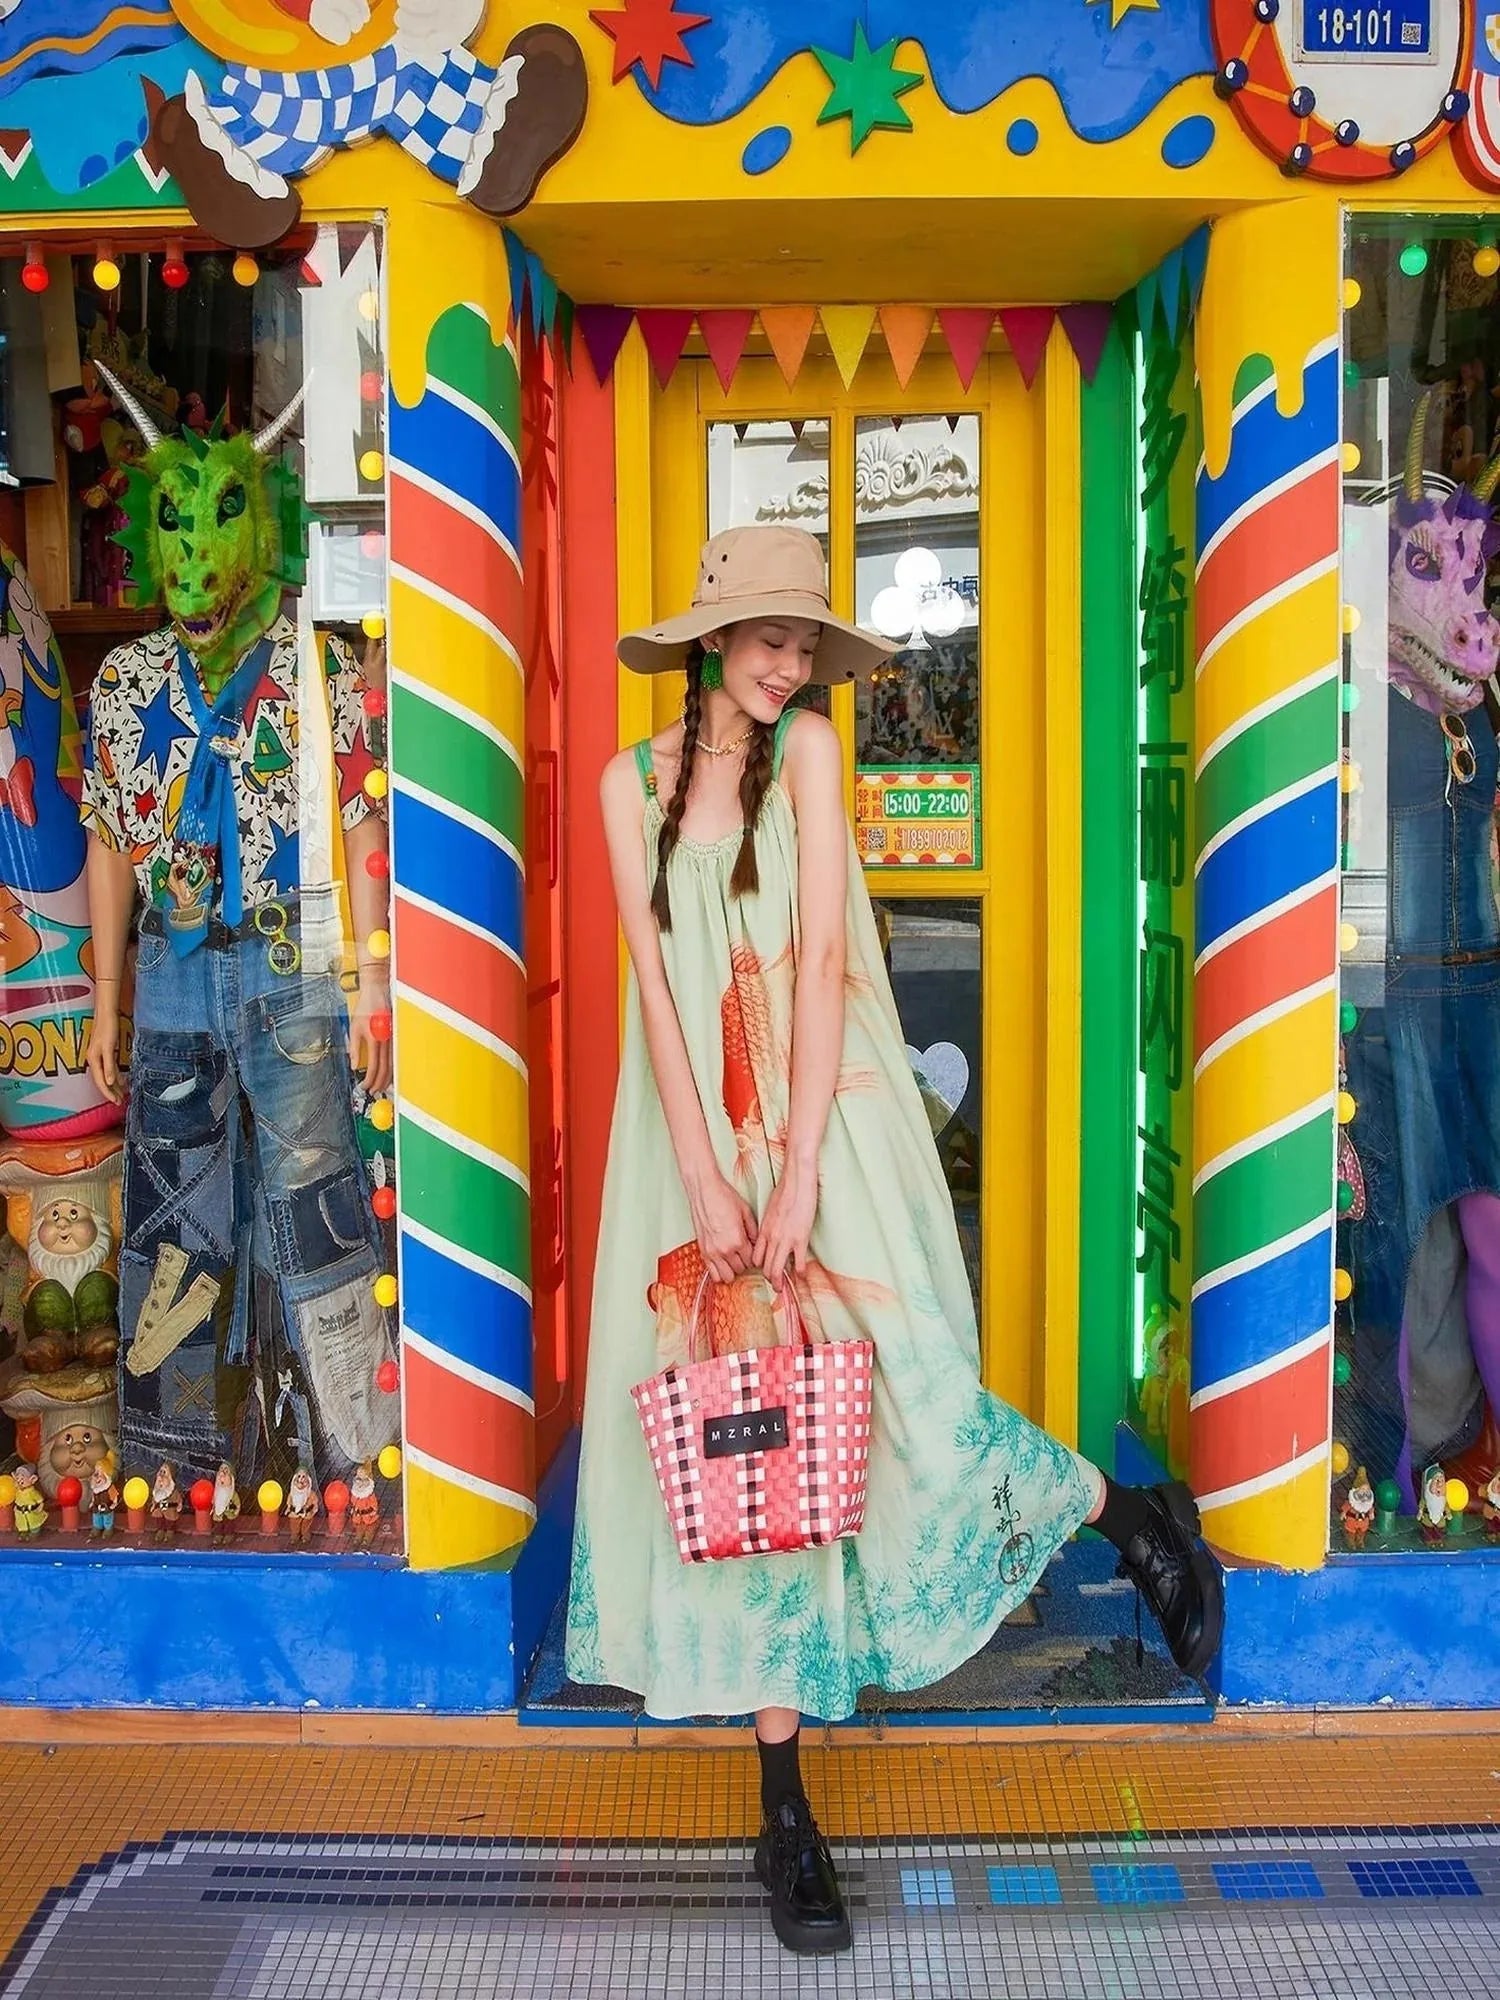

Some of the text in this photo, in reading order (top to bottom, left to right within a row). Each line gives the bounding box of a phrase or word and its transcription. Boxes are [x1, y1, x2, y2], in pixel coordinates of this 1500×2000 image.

[1318, 8, 1392, 45] 18-101
[885, 793, 968, 814] 15:00-22:00
[1135, 345, 1188, 1313] 多绮丽闪亮
[711, 1422, 782, 1442] MZRAL
